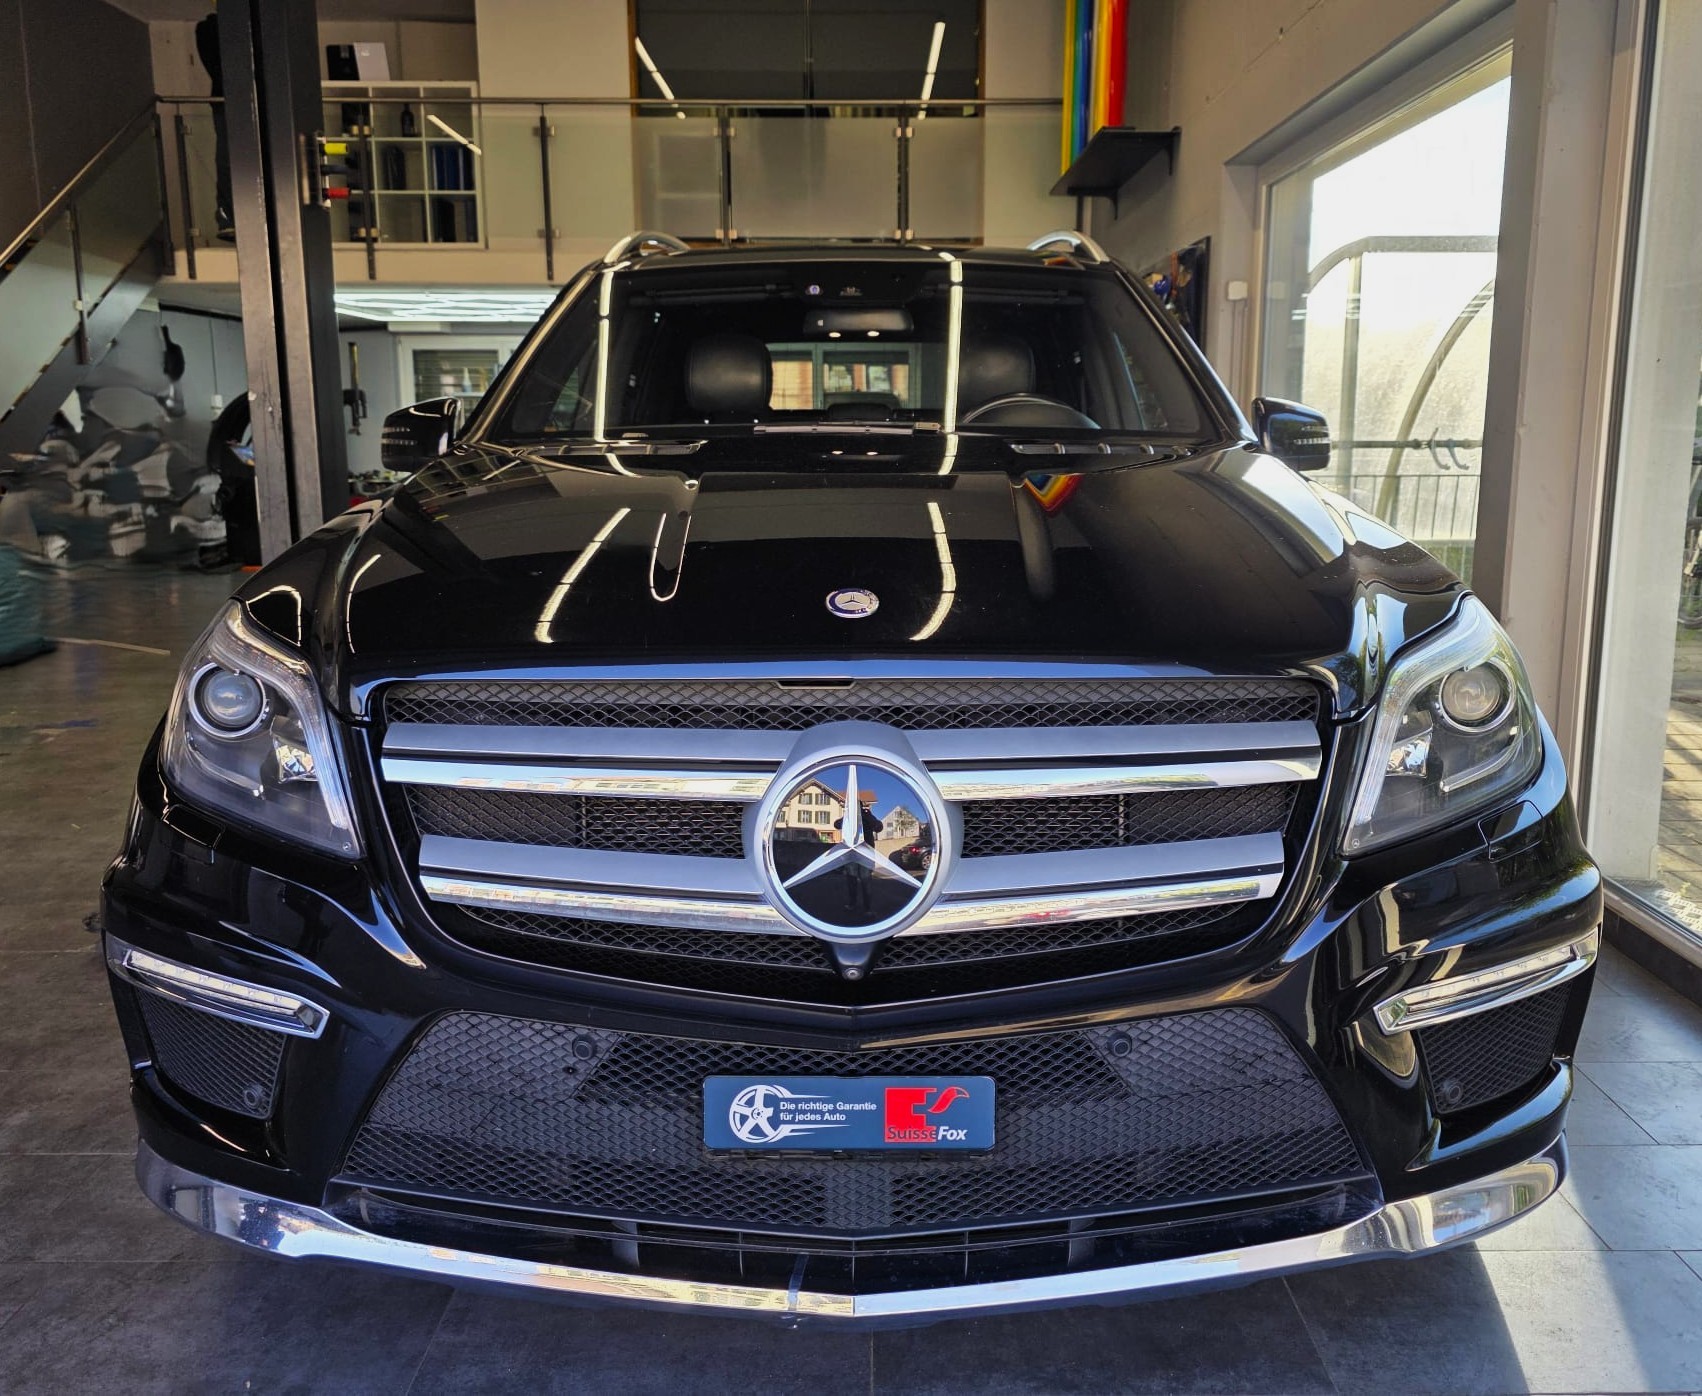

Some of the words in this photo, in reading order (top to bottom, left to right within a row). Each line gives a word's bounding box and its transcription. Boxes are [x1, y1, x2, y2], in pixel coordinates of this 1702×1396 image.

[780, 1102, 796, 1110] Die
[798, 1102, 834, 1111] richtige
[836, 1102, 877, 1110] Garantie
[780, 1112, 793, 1120] für
[795, 1112, 821, 1122] jedes
[823, 1112, 846, 1120] Auto
